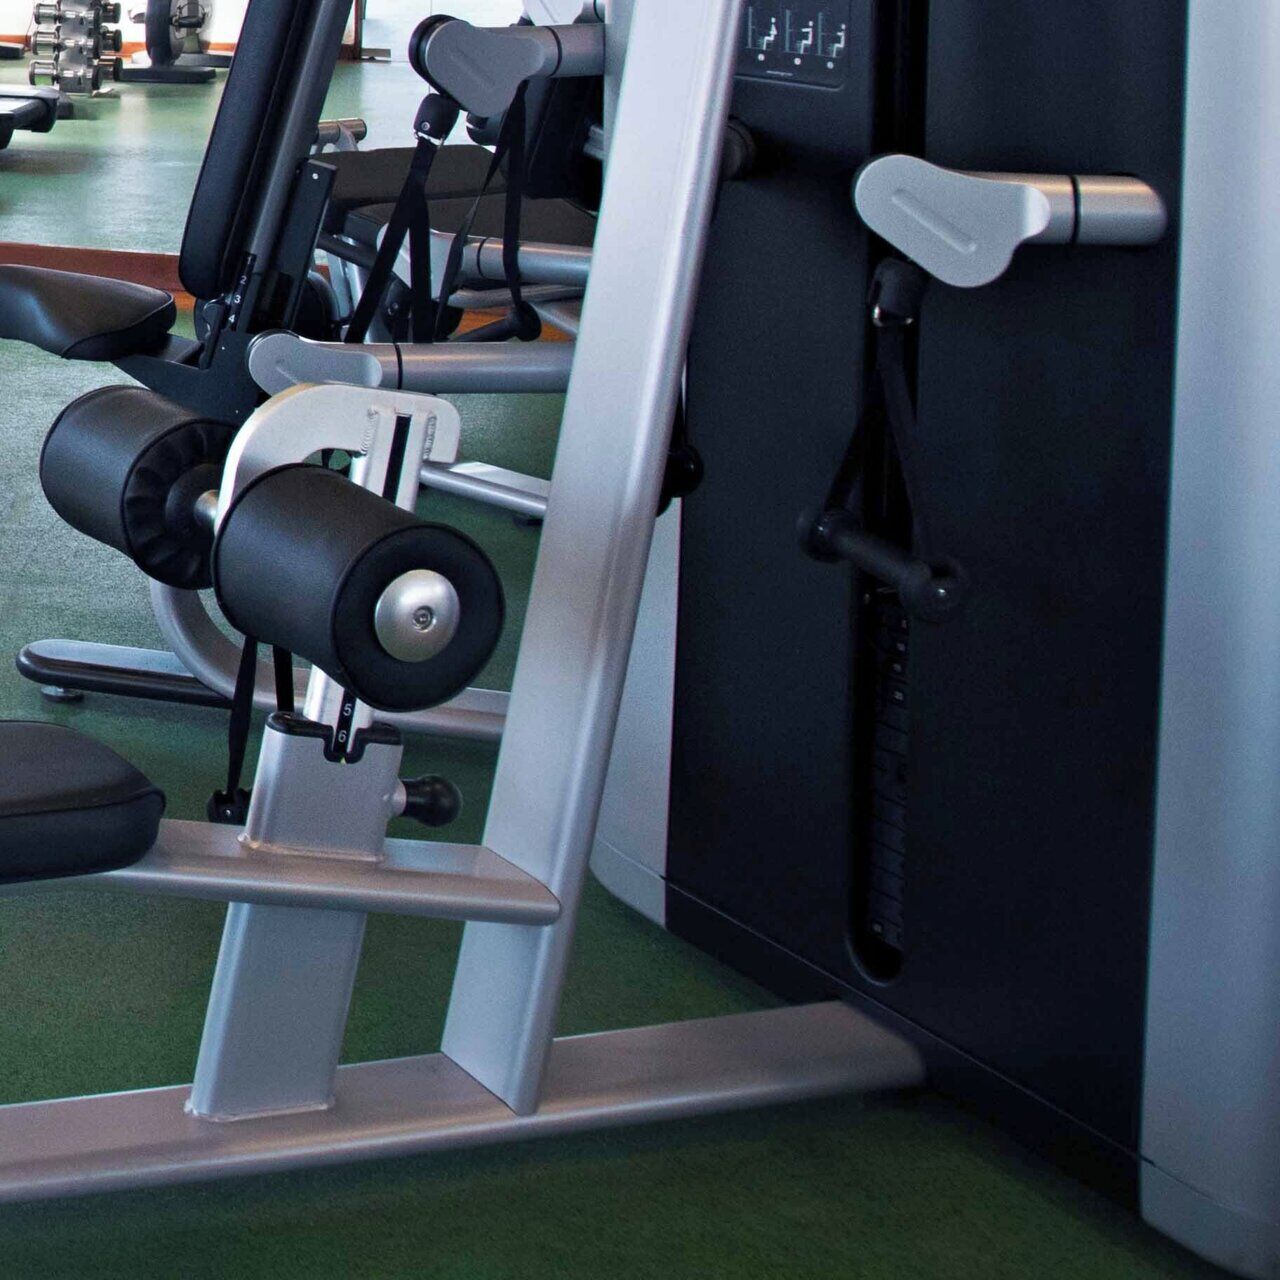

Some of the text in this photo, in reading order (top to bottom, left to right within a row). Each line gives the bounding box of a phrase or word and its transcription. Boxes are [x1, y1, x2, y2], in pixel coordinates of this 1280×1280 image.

[247, 255, 252, 265] 1
[240, 275, 247, 285] 2
[234, 294, 241, 304] 3
[228, 314, 236, 323] 4
[343, 703, 353, 716] 5
[338, 730, 347, 743] 6
